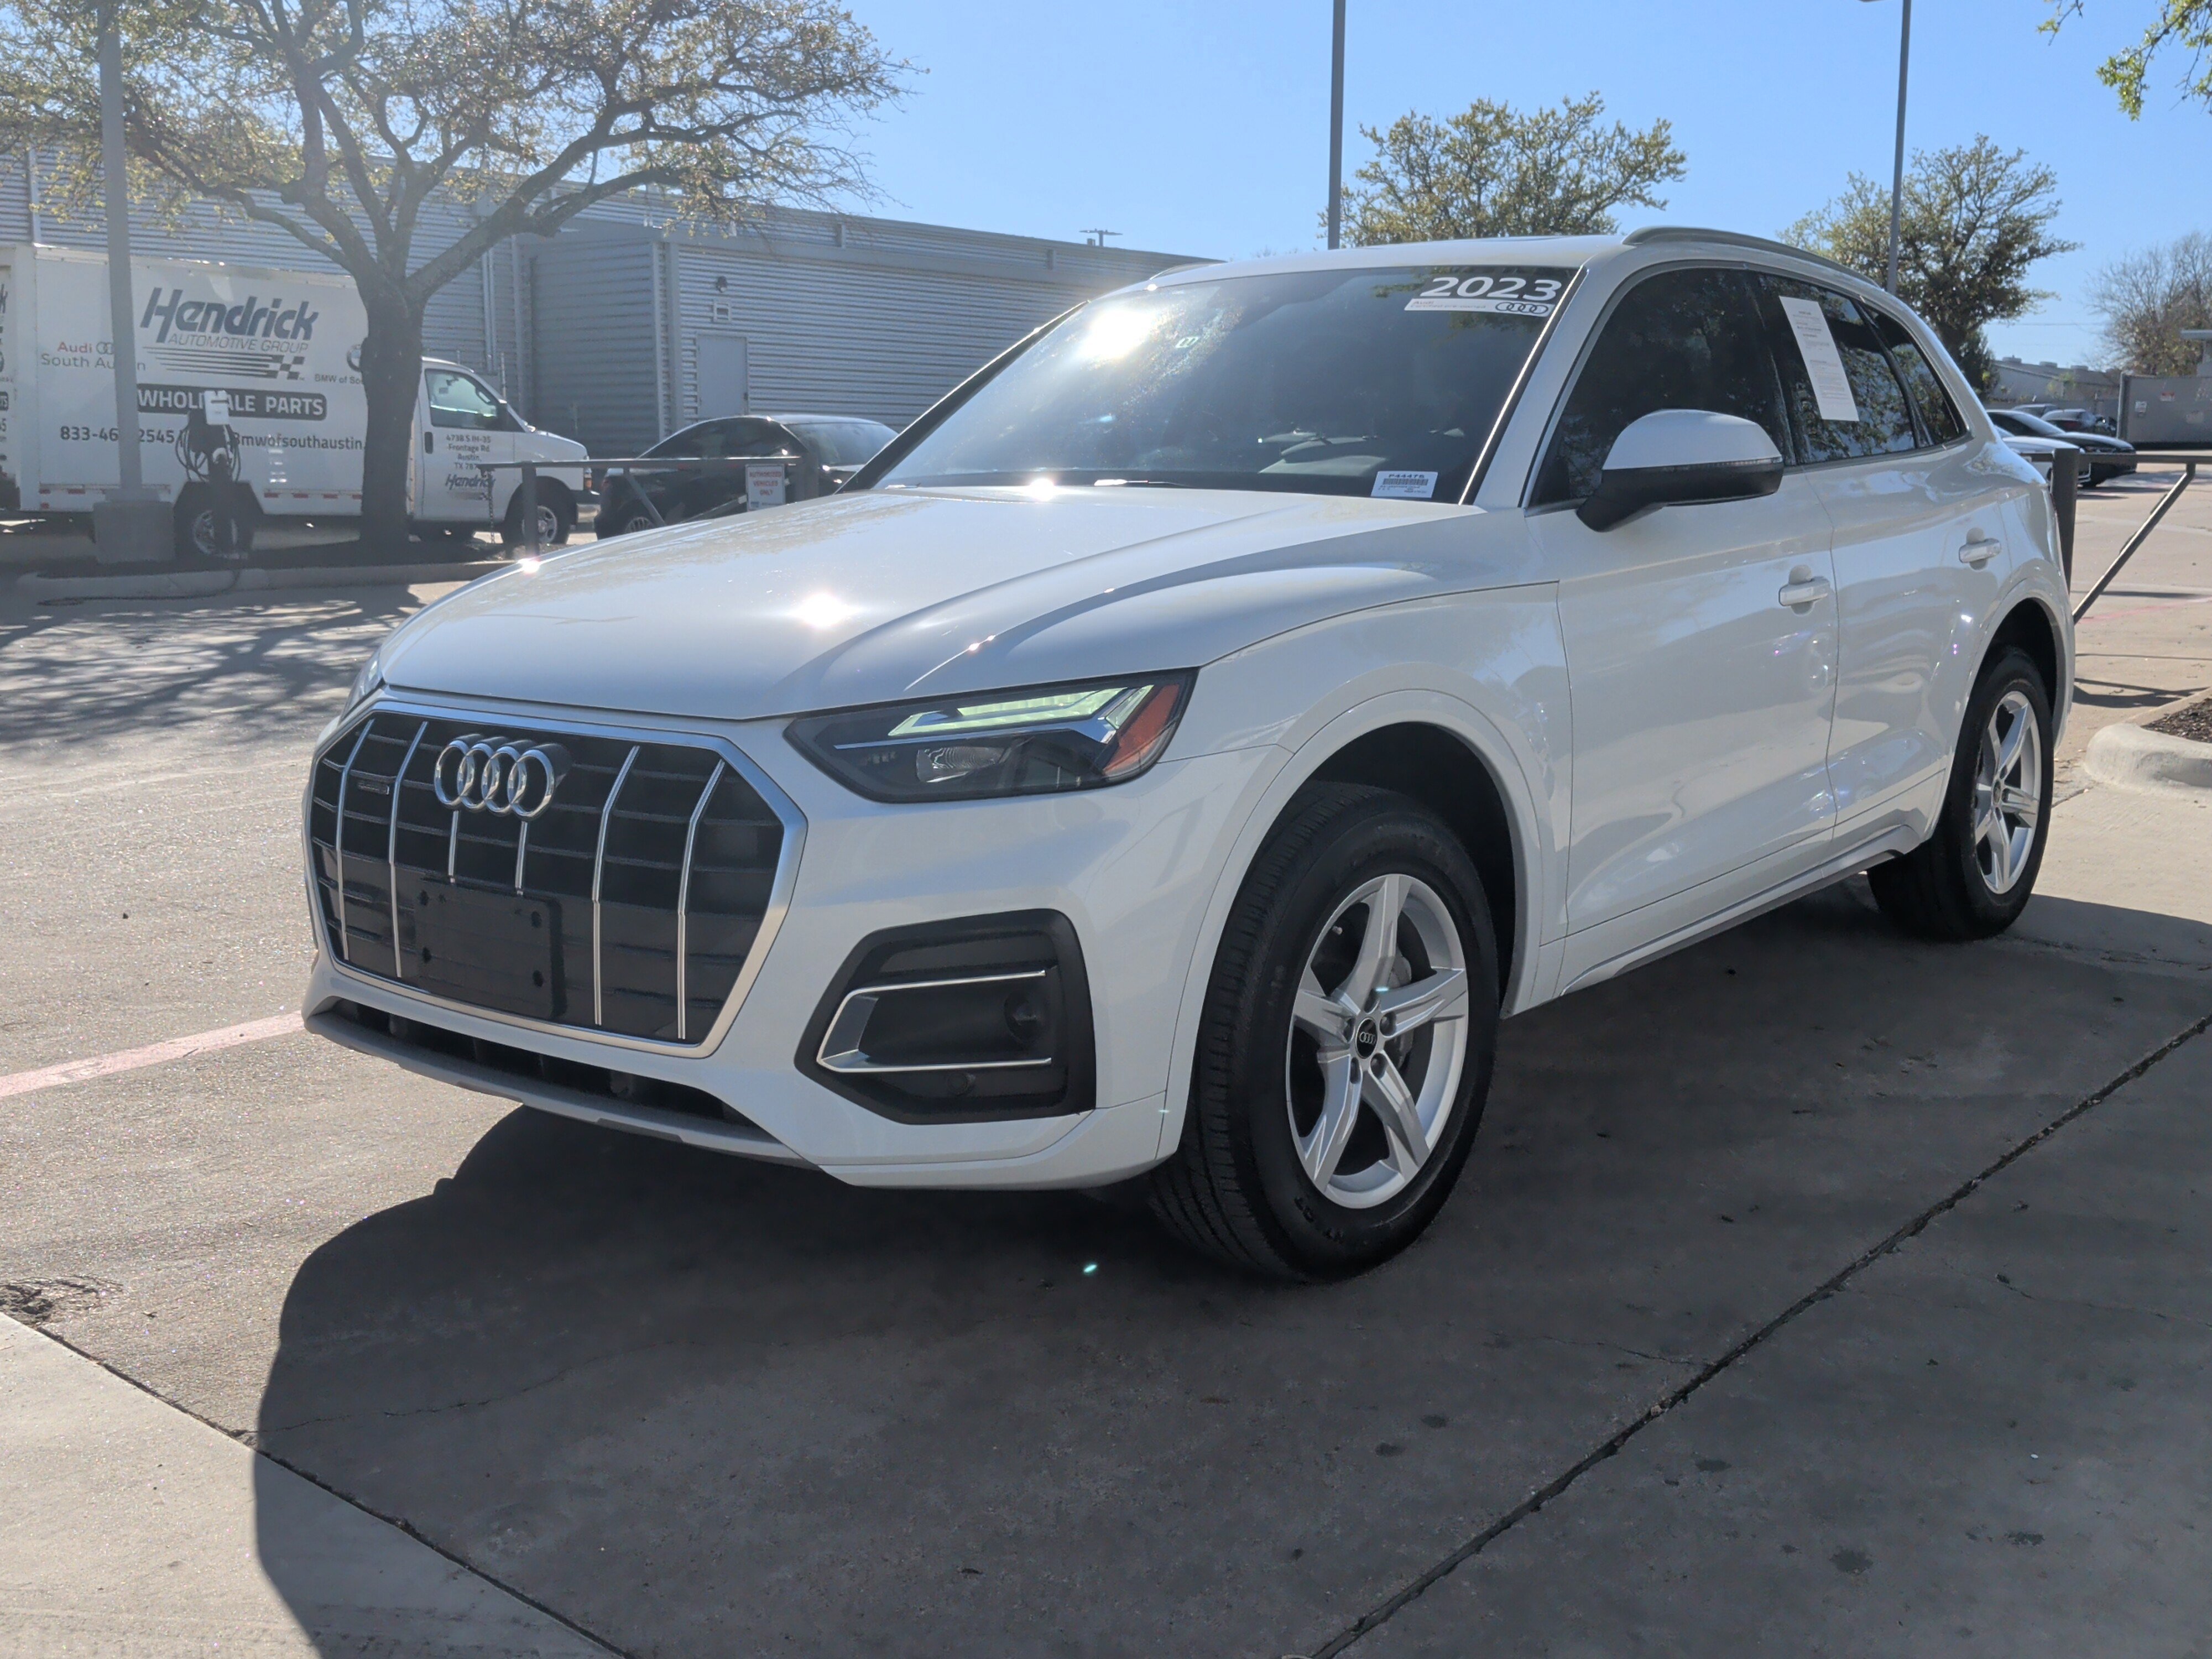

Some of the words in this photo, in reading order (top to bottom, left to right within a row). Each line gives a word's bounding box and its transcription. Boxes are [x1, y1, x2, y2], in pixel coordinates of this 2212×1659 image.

[1420, 276, 1562, 301] 2023
[140, 286, 319, 343] Hendrick
[57, 341, 92, 353] Audi
[169, 333, 258, 351] AUTOMOTIVE
[261, 340, 309, 353] GROUP
[41, 353, 90, 368] South
[314, 373, 336, 383] BMW
[138, 389, 256, 412] WHOLALE
[265, 397, 324, 415] PARTS
